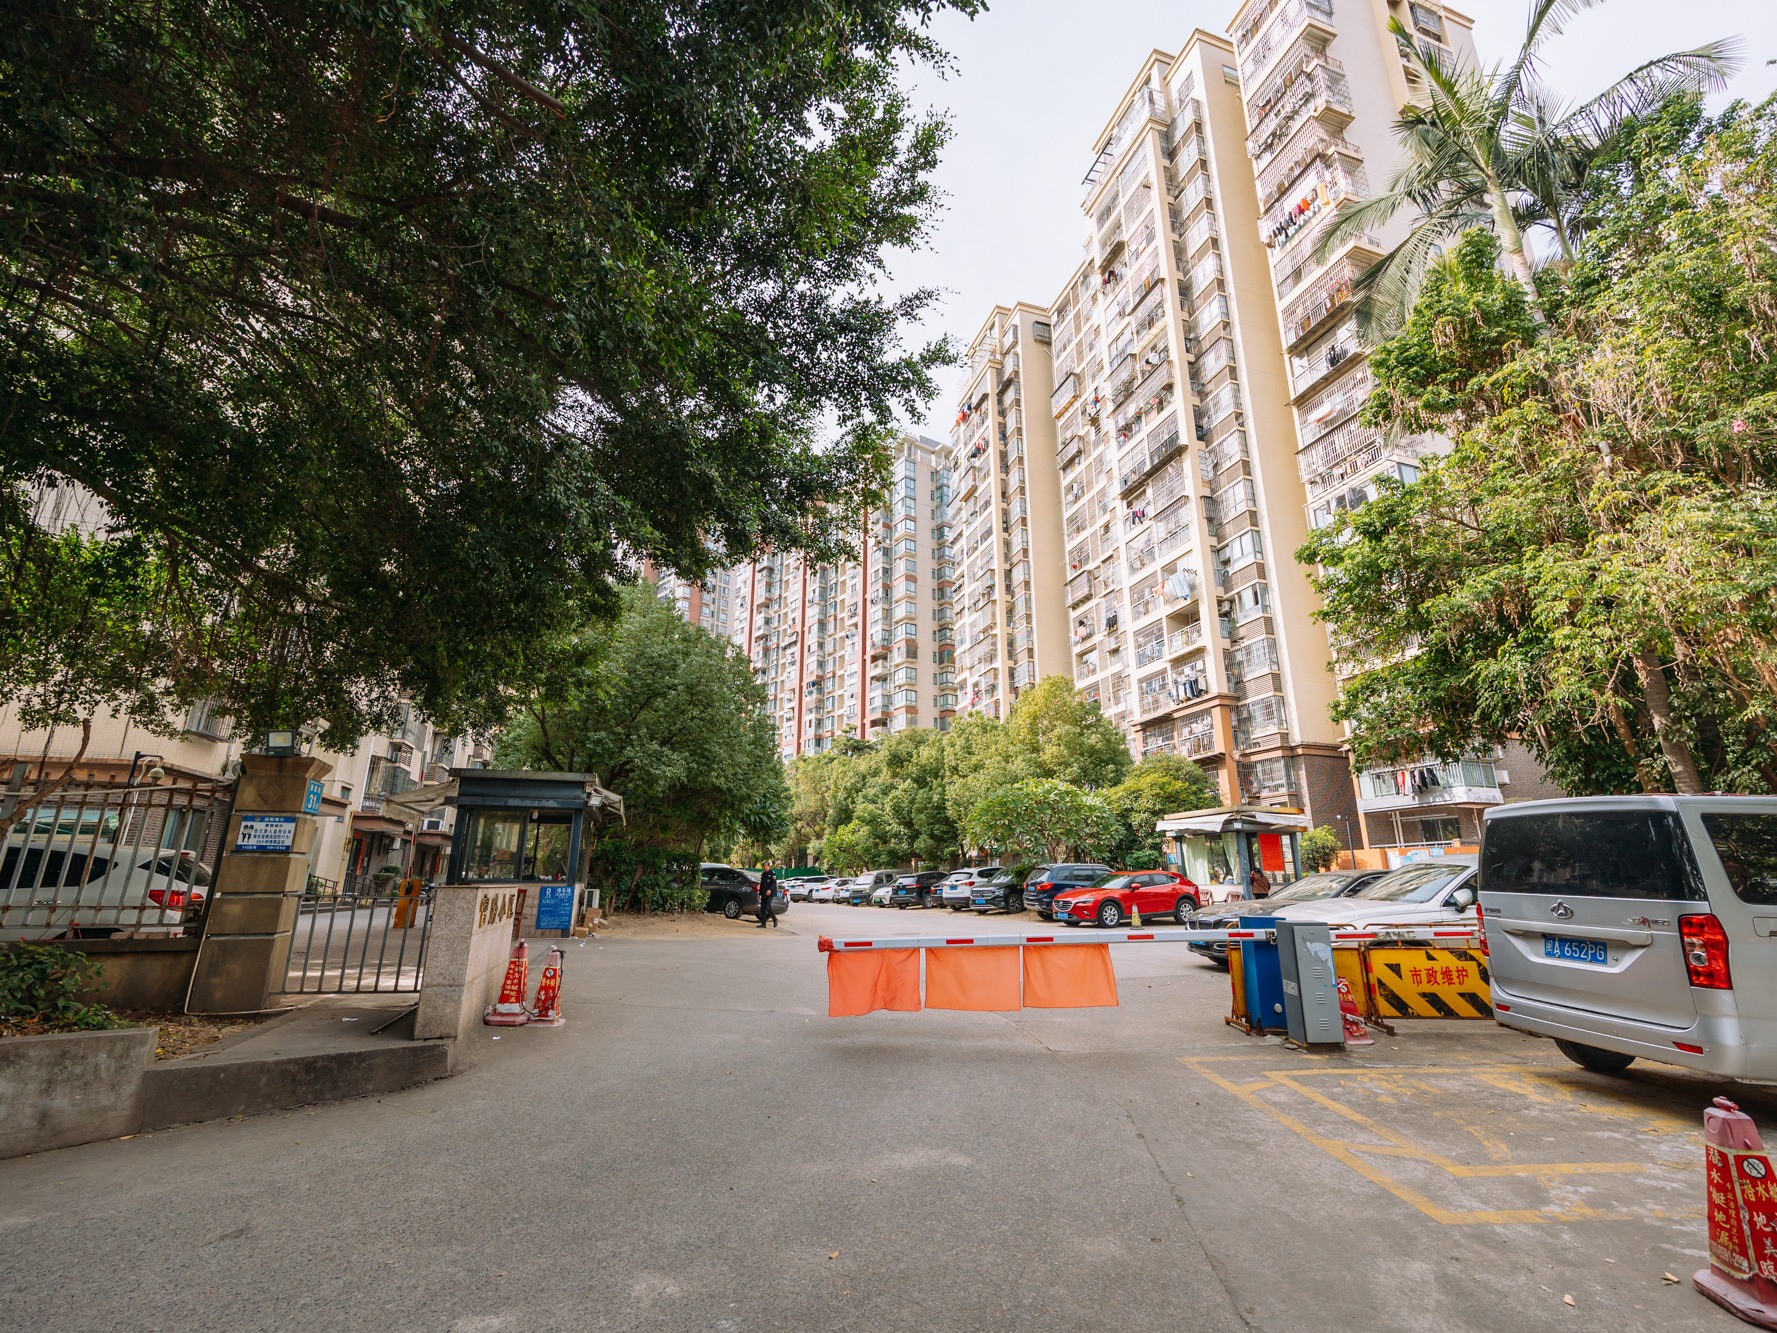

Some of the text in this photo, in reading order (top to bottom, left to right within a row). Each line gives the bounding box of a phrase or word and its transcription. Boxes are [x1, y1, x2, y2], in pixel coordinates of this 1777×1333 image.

[1409, 966, 1469, 987] 市政维护
[1707, 1146, 1733, 1250] 潜水艇地漏
